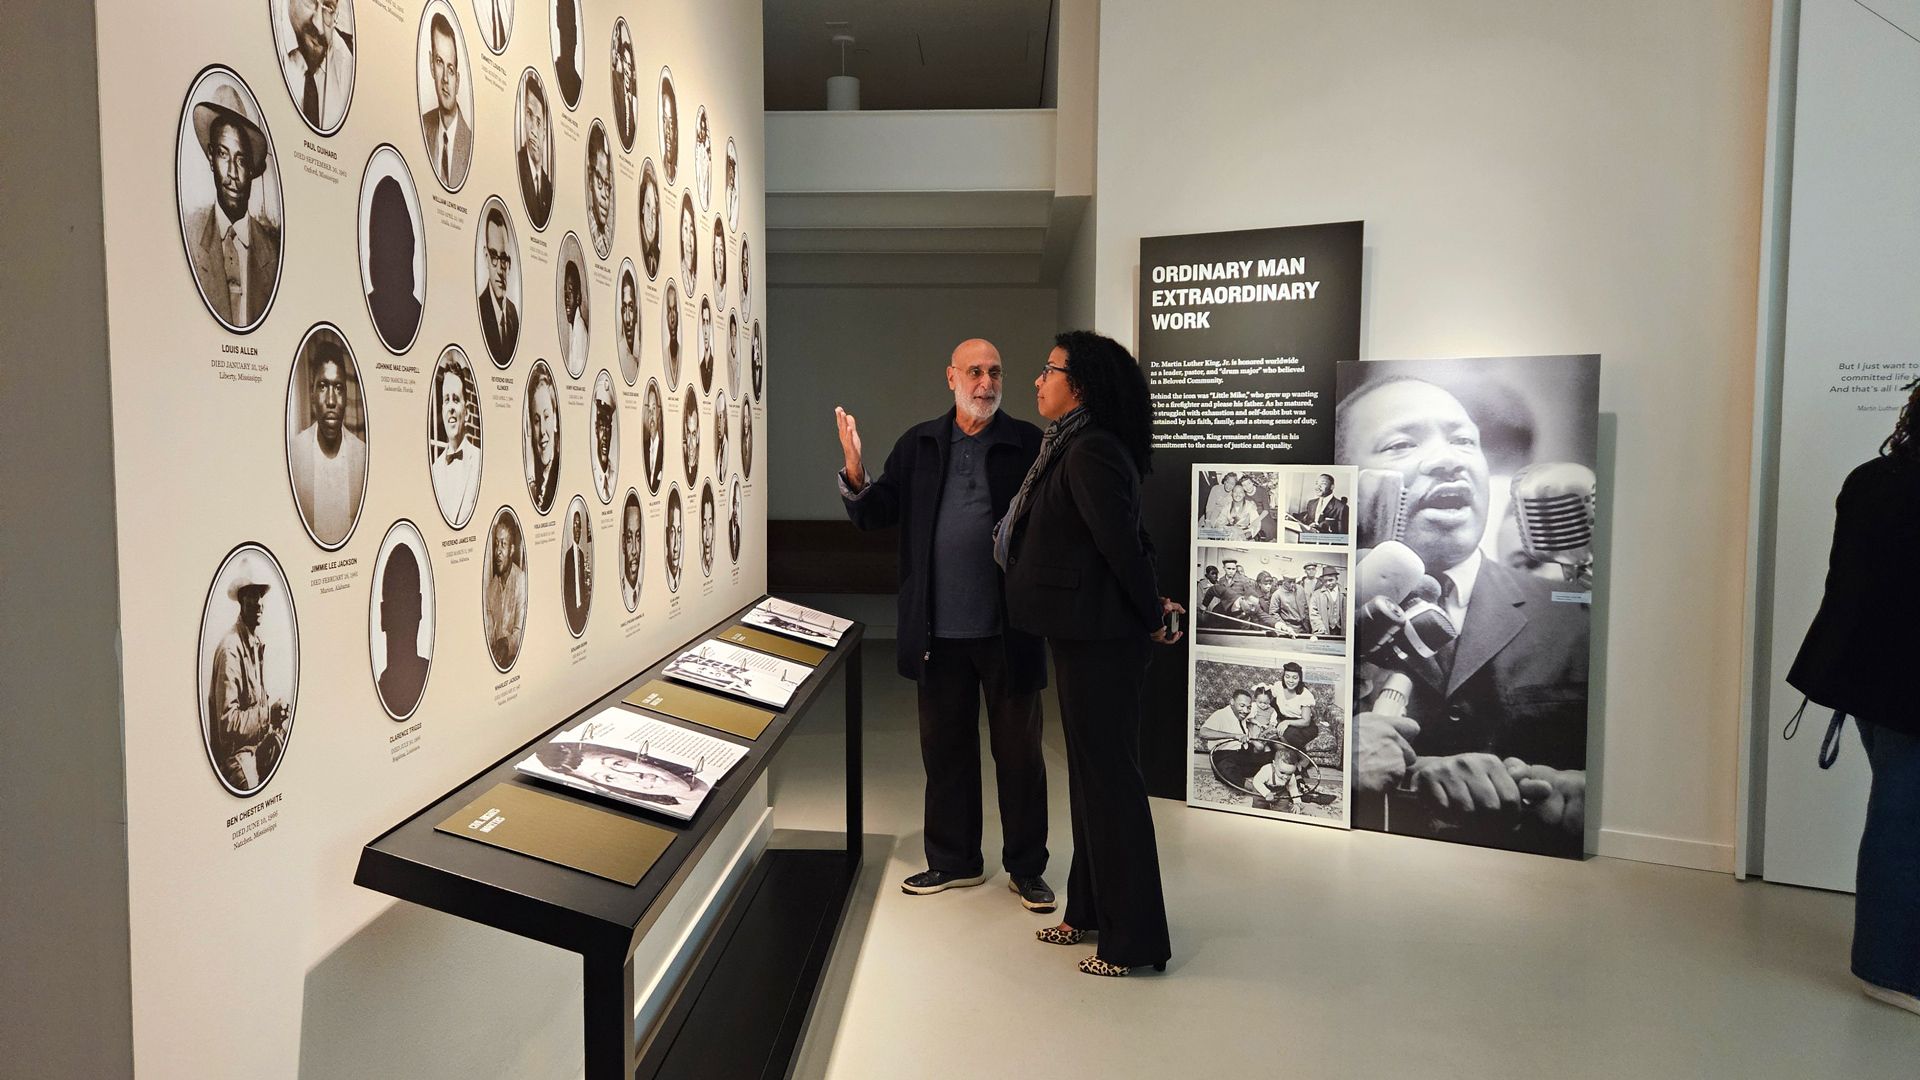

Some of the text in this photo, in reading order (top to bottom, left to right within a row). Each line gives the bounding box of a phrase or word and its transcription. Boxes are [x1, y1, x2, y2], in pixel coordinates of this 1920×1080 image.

[1152, 257, 1305, 284] ORDINARY MAN
[1152, 281, 1320, 307] EXTRAORDINARY
[1151, 311, 1210, 331] WORK
[222, 344, 258, 356] LOUIS ALLEN
[211, 360, 226, 368] DIED
[1862, 362, 1880, 371] just
[1187, 377, 1224, 385] Community.
[1841, 374, 1892, 382] committed
[1829, 385, 1849, 393] And
[1292, 390, 1318, 398] wanting
[1170, 401, 1200, 409] firefighter
[1284, 399, 1313, 407] matured,
[1158, 410, 1185, 418] struggled
[1179, 418, 1186, 426] by
[1214, 418, 1234, 426] family,
[1173, 433, 1205, 441] challenges,
[1230, 442, 1252, 450] justice
[1266, 442, 1293, 450] equality.
[337, 558, 358, 567] JACKSON
[226, 793, 282, 828] BEN CHESTER WHITE
[232, 828, 246, 840] DIED
